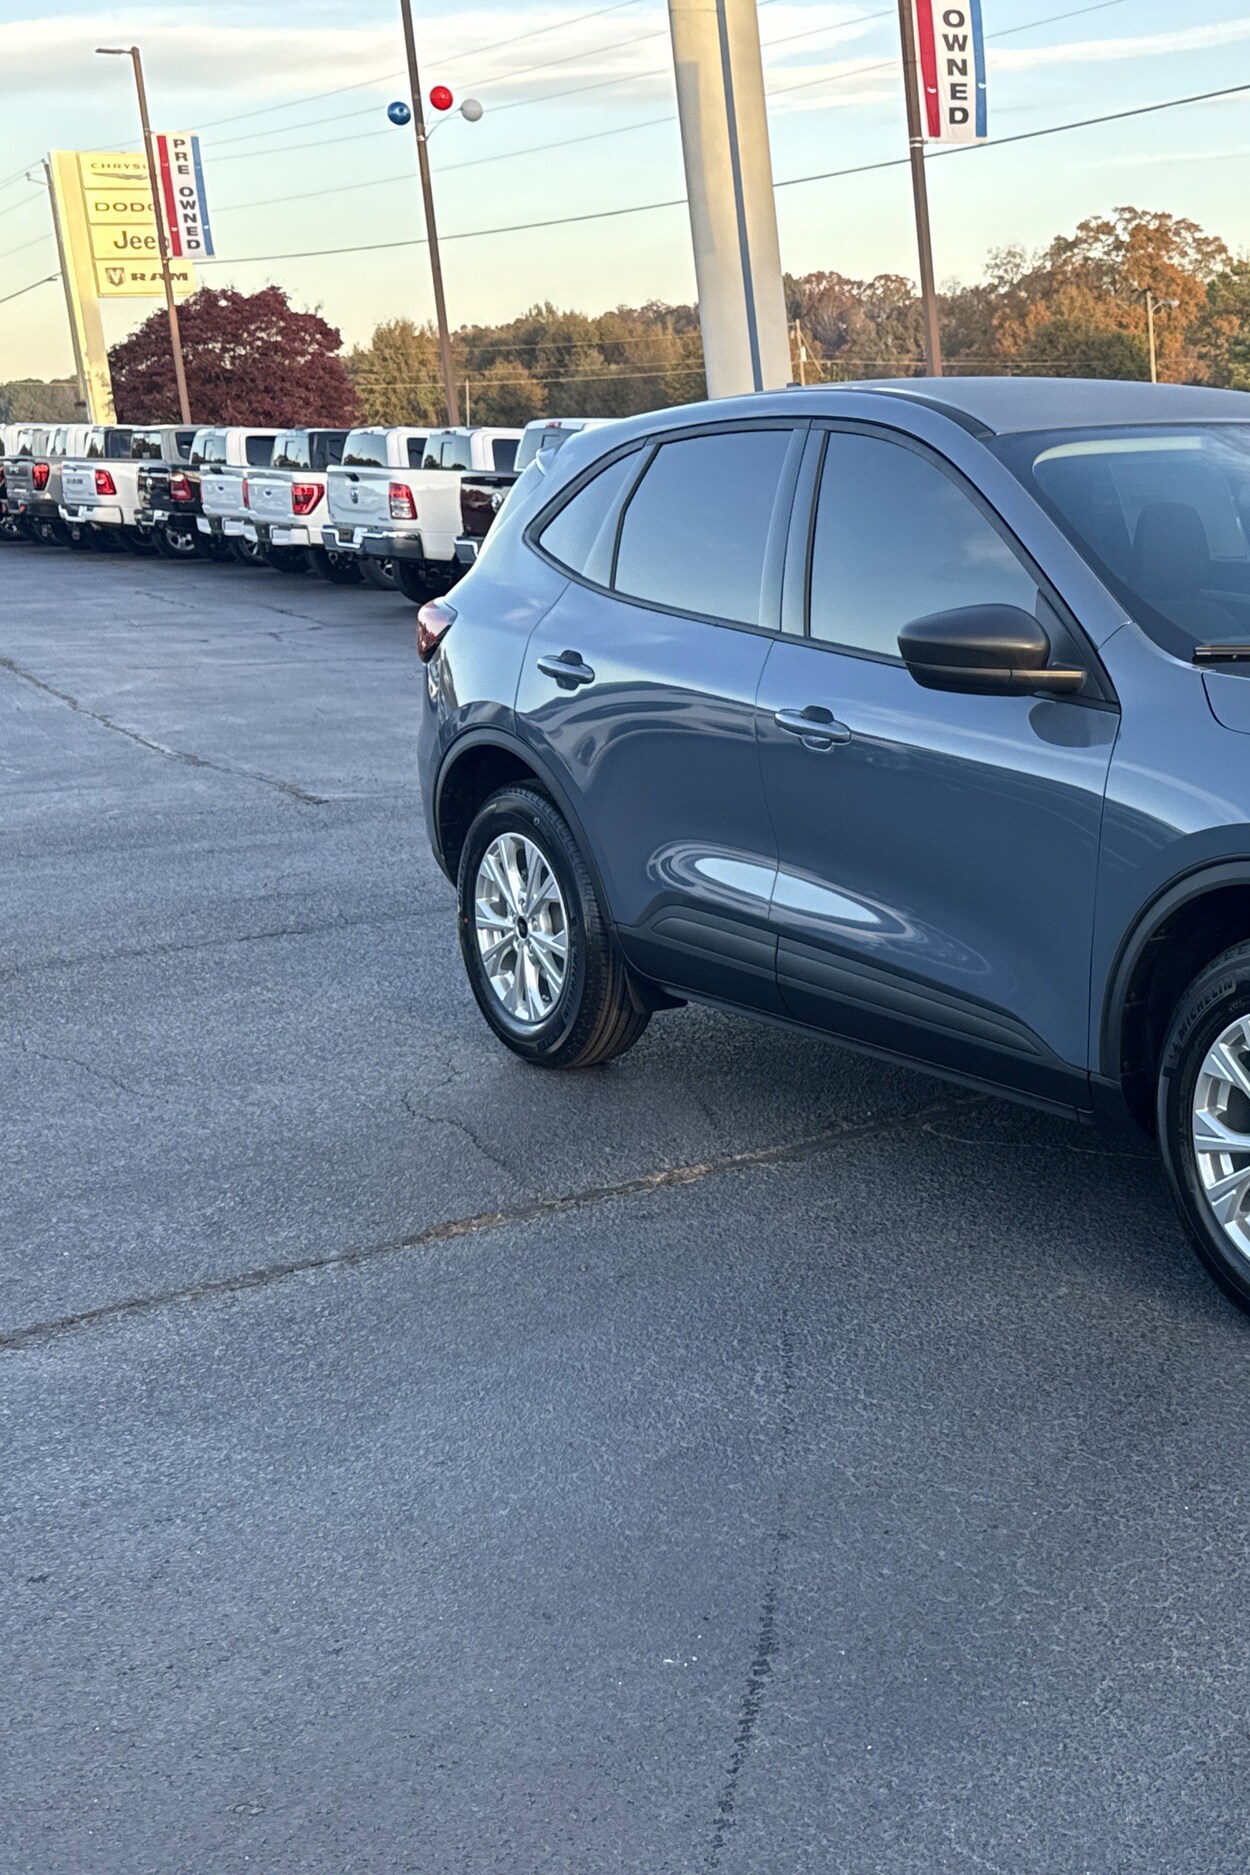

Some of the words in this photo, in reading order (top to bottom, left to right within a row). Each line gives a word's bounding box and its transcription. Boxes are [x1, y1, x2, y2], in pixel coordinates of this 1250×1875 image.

[942, 9, 970, 125] OWNED
[173, 139, 190, 175] PRE
[113, 230, 158, 250] Jee
[179, 186, 201, 250] OWNED
[131, 272, 189, 281] RAM
[1178, 975, 1235, 1042] MICHELIN
